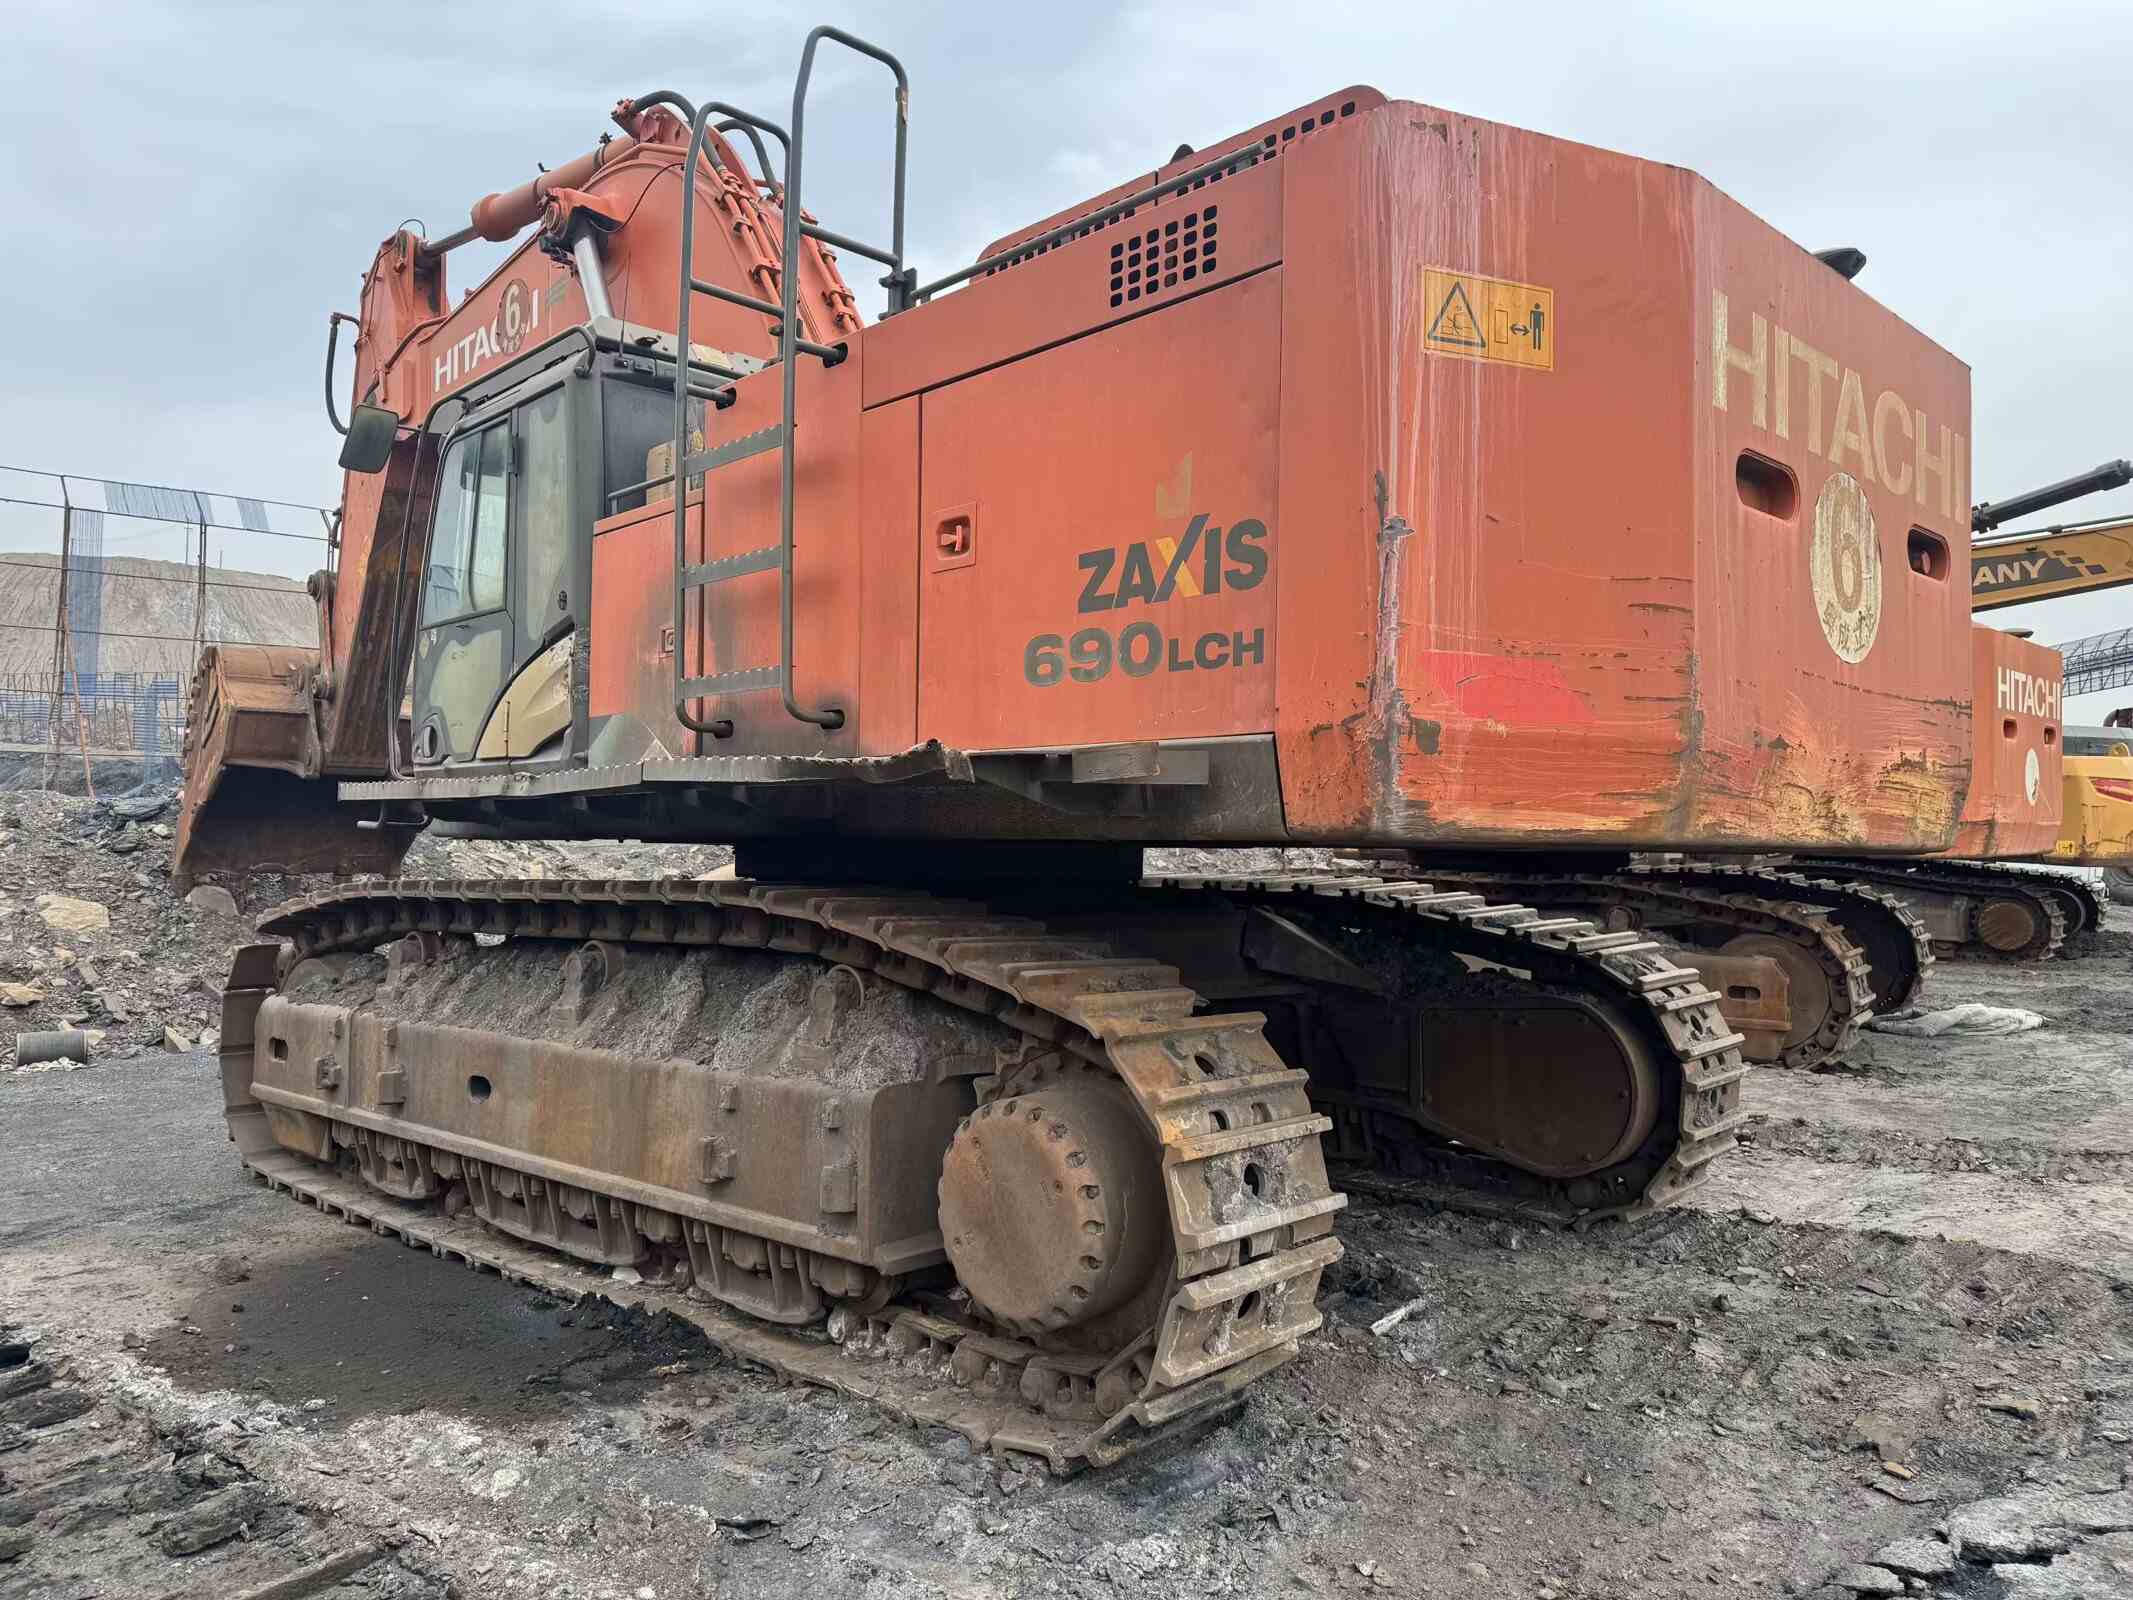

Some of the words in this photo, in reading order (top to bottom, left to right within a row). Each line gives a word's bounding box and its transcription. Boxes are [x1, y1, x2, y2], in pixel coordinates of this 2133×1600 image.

[435, 288, 539, 392] HITACI
[505, 284, 521, 338] 6
[1712, 288, 1965, 524] HITACHI
[1078, 512, 1268, 614] ZAXIS
[1831, 486, 1863, 613] 6
[1998, 666, 2061, 720] HITACHI
